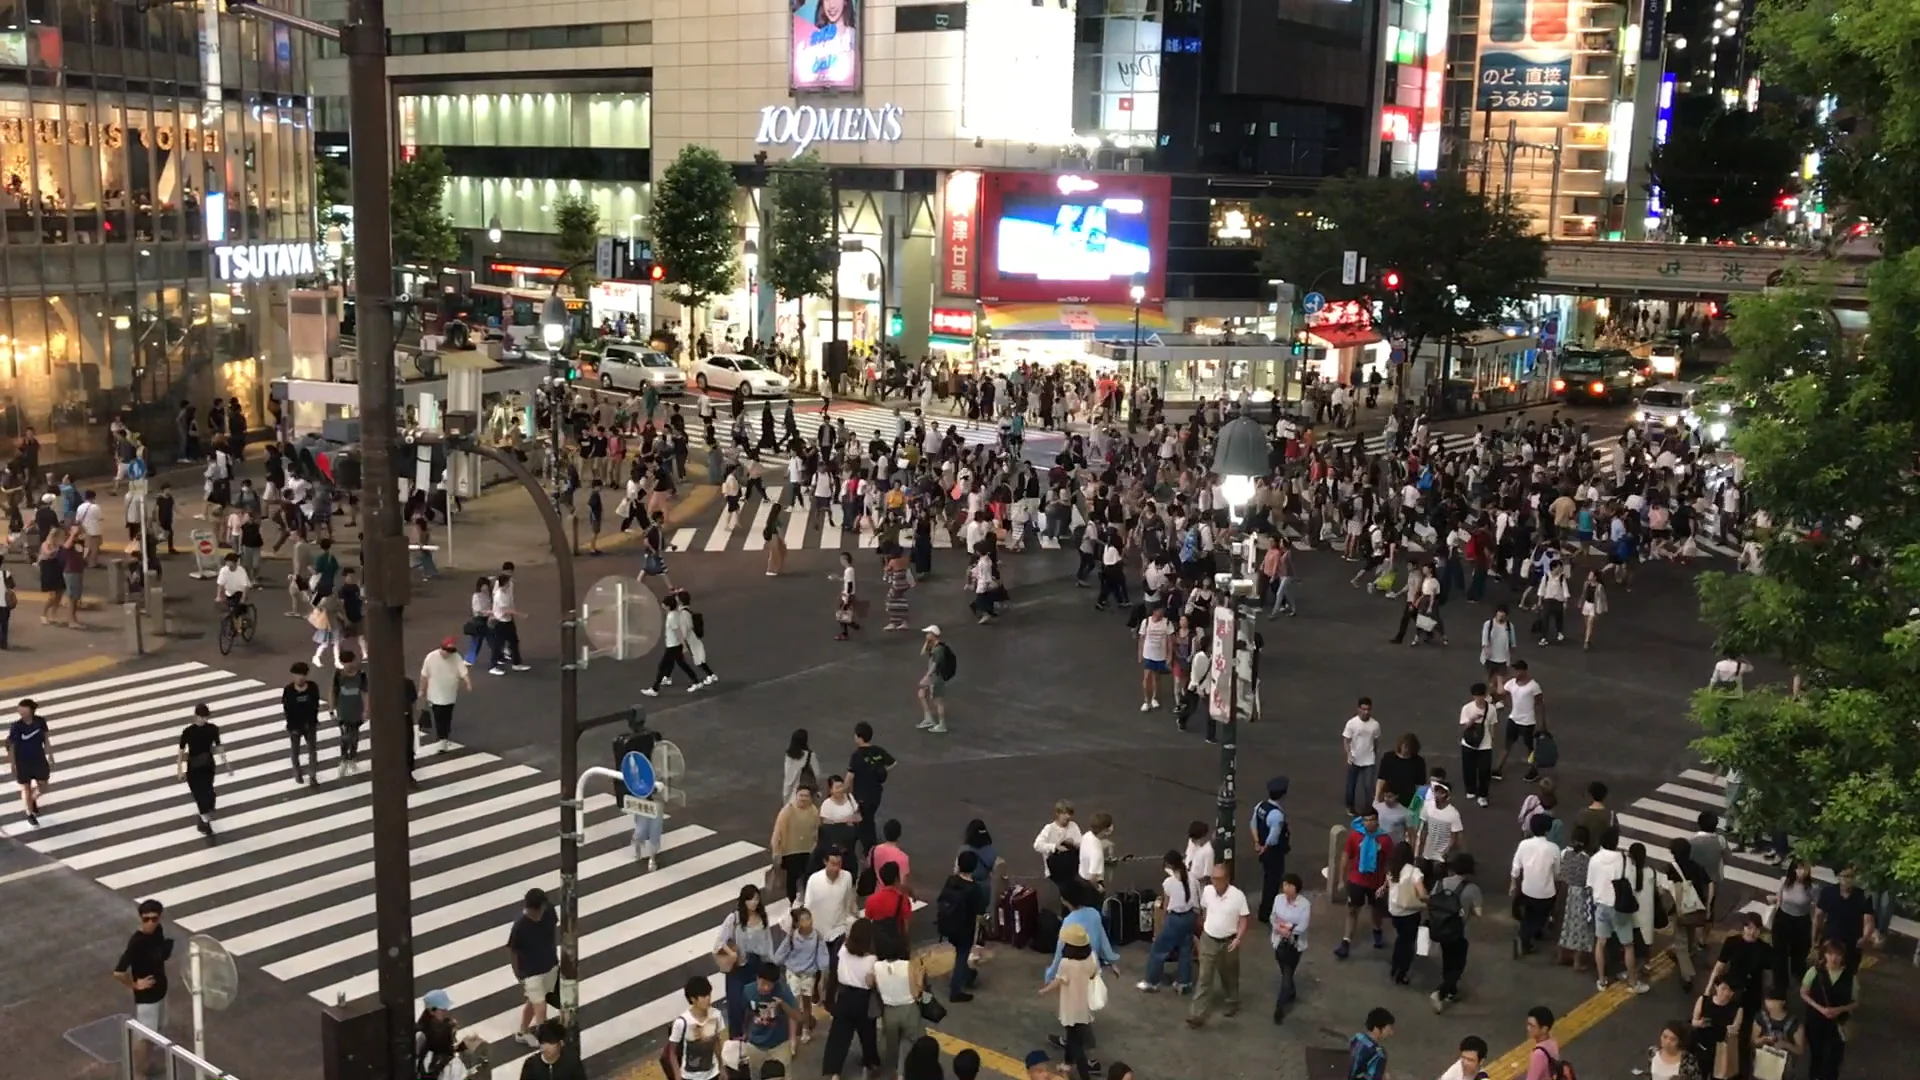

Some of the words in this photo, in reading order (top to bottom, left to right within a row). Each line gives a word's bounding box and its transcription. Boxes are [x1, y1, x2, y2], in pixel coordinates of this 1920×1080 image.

[1483, 67, 1568, 85] のど、直接、
[1489, 90, 1554, 107] うるおう
[951, 194, 968, 291] 津甘栗
[215, 243, 313, 280] TSUTAYA
